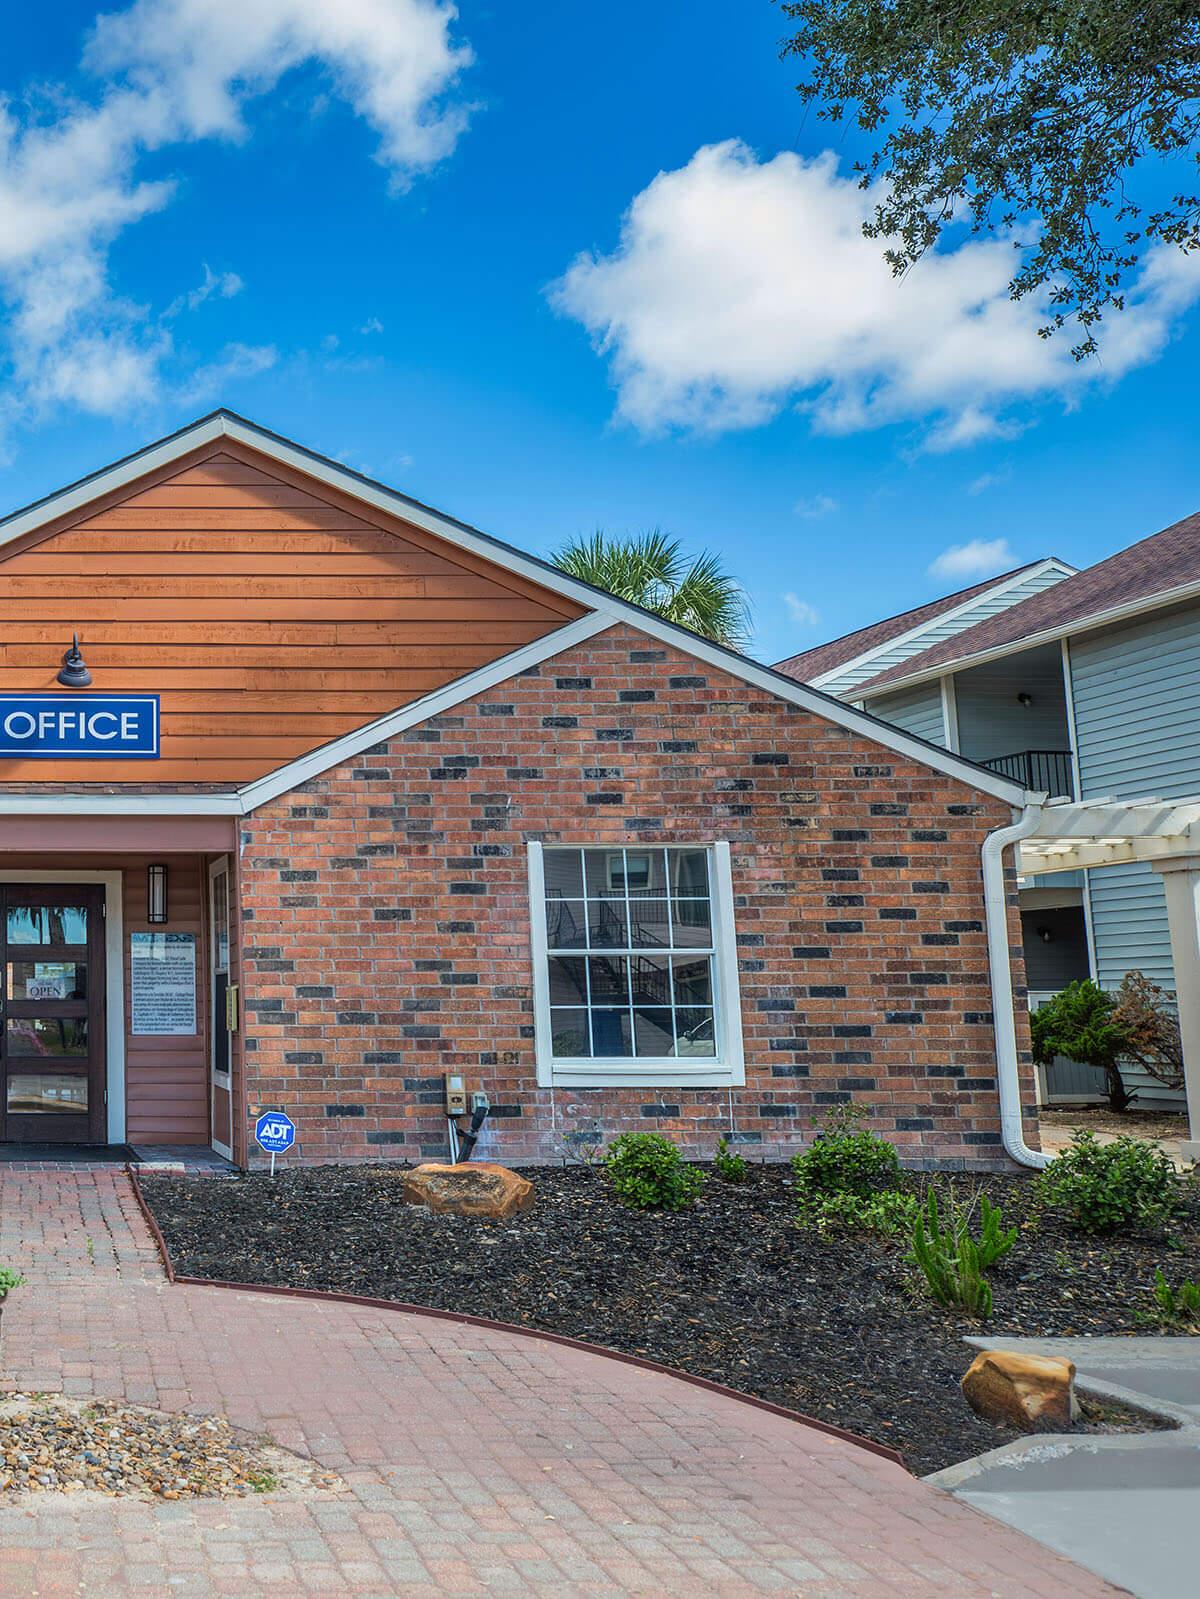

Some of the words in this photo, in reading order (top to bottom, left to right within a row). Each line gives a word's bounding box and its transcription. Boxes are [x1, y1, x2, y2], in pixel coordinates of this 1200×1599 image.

[4, 711, 139, 740] OFFICE
[30, 987, 62, 997] OPEN
[260, 1122, 292, 1140] ADT
